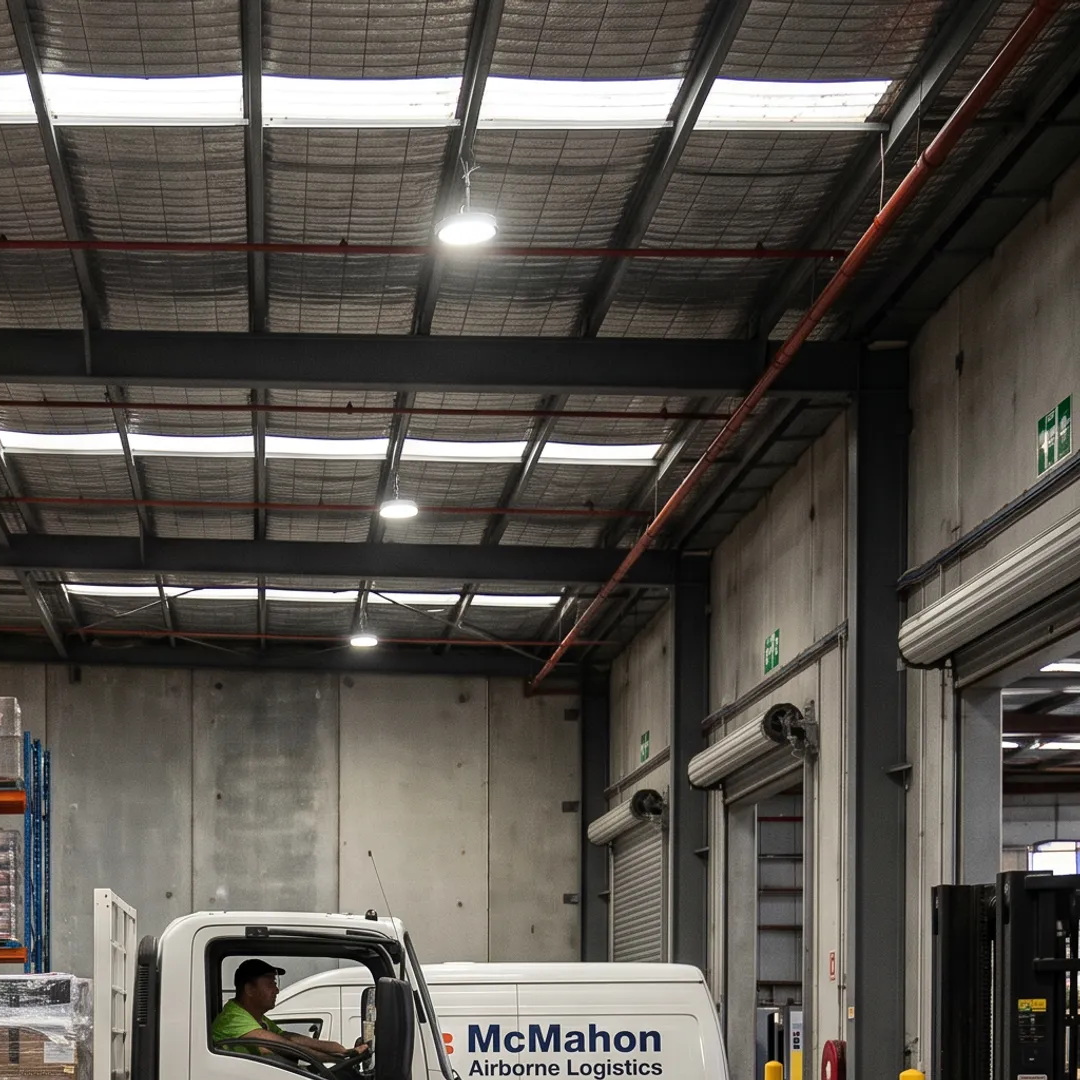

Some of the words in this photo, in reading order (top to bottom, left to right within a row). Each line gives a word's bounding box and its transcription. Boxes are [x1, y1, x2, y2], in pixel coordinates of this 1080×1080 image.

[469, 1024, 662, 1054] McMahon
[469, 1059, 560, 1077] Airborne
[567, 1059, 663, 1080] Logistics
